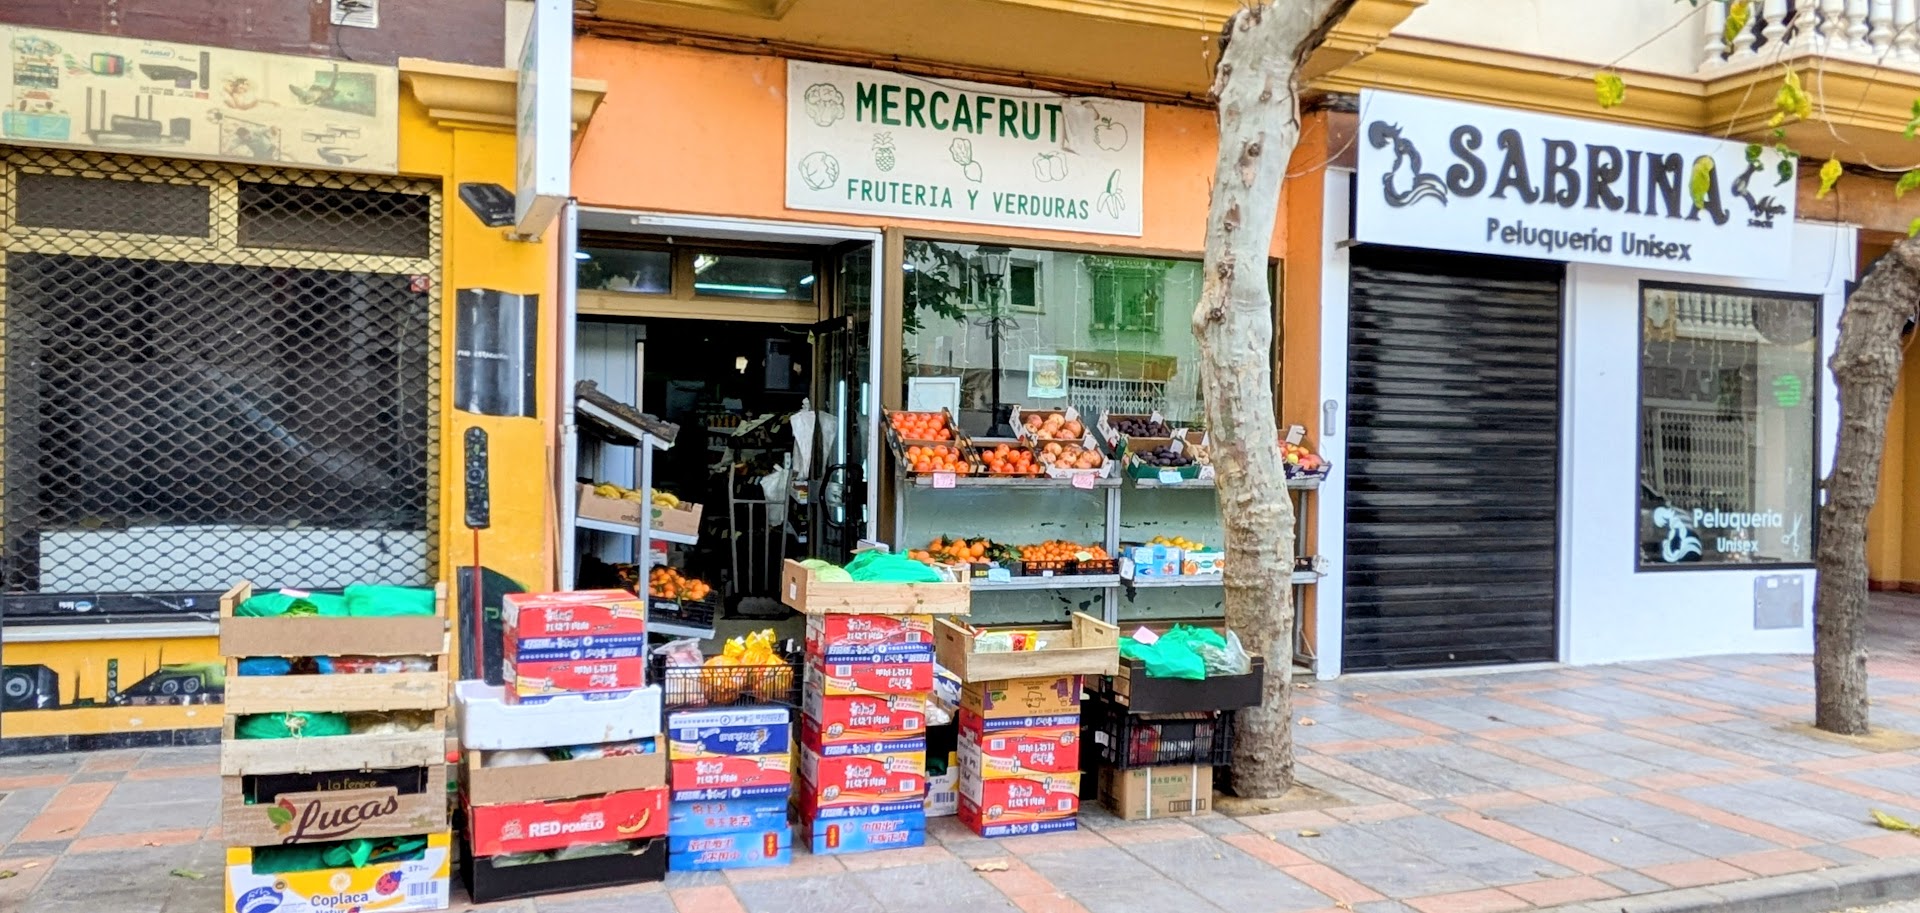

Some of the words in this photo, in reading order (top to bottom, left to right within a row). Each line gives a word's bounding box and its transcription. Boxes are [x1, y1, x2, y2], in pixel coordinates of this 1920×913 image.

[855, 81, 1063, 143] MERCAFRUT
[1446, 124, 1730, 226] SABRINA
[847, 179, 952, 209] FRUTERIA
[967, 190, 978, 211] Y
[993, 191, 1090, 221] VERDURAS
[1622, 231, 1692, 262] Unisex
[1716, 536, 1759, 553] Unisex
[283, 795, 398, 845] Lucas
[528, 822, 561, 838] RED
[562, 820, 605, 834] POMELO
[311, 892, 369, 908] Coplaca
